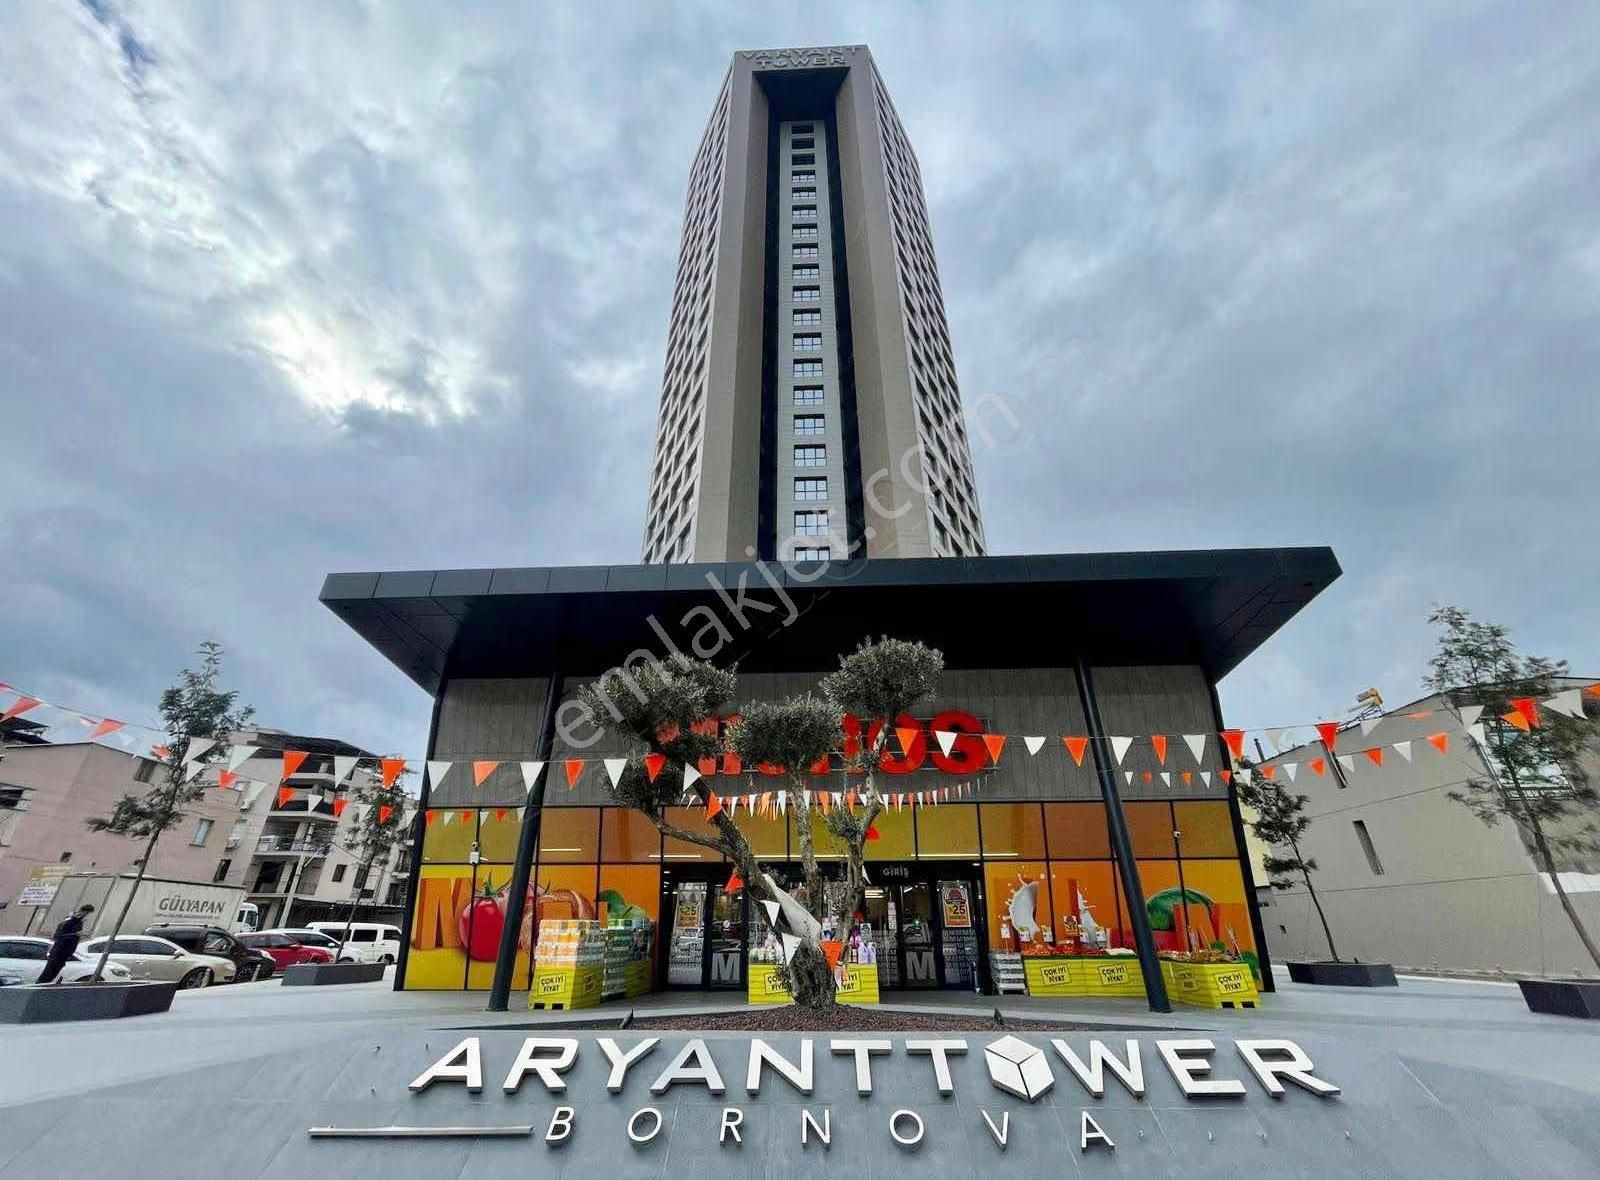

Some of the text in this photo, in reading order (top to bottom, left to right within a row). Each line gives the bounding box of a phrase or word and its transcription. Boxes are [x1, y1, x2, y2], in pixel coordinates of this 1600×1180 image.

[756, 54, 849, 68] TOWER
[159, 895, 226, 913] GÜLYAPAN
[545, 1106, 1115, 1148] BORNOVA
